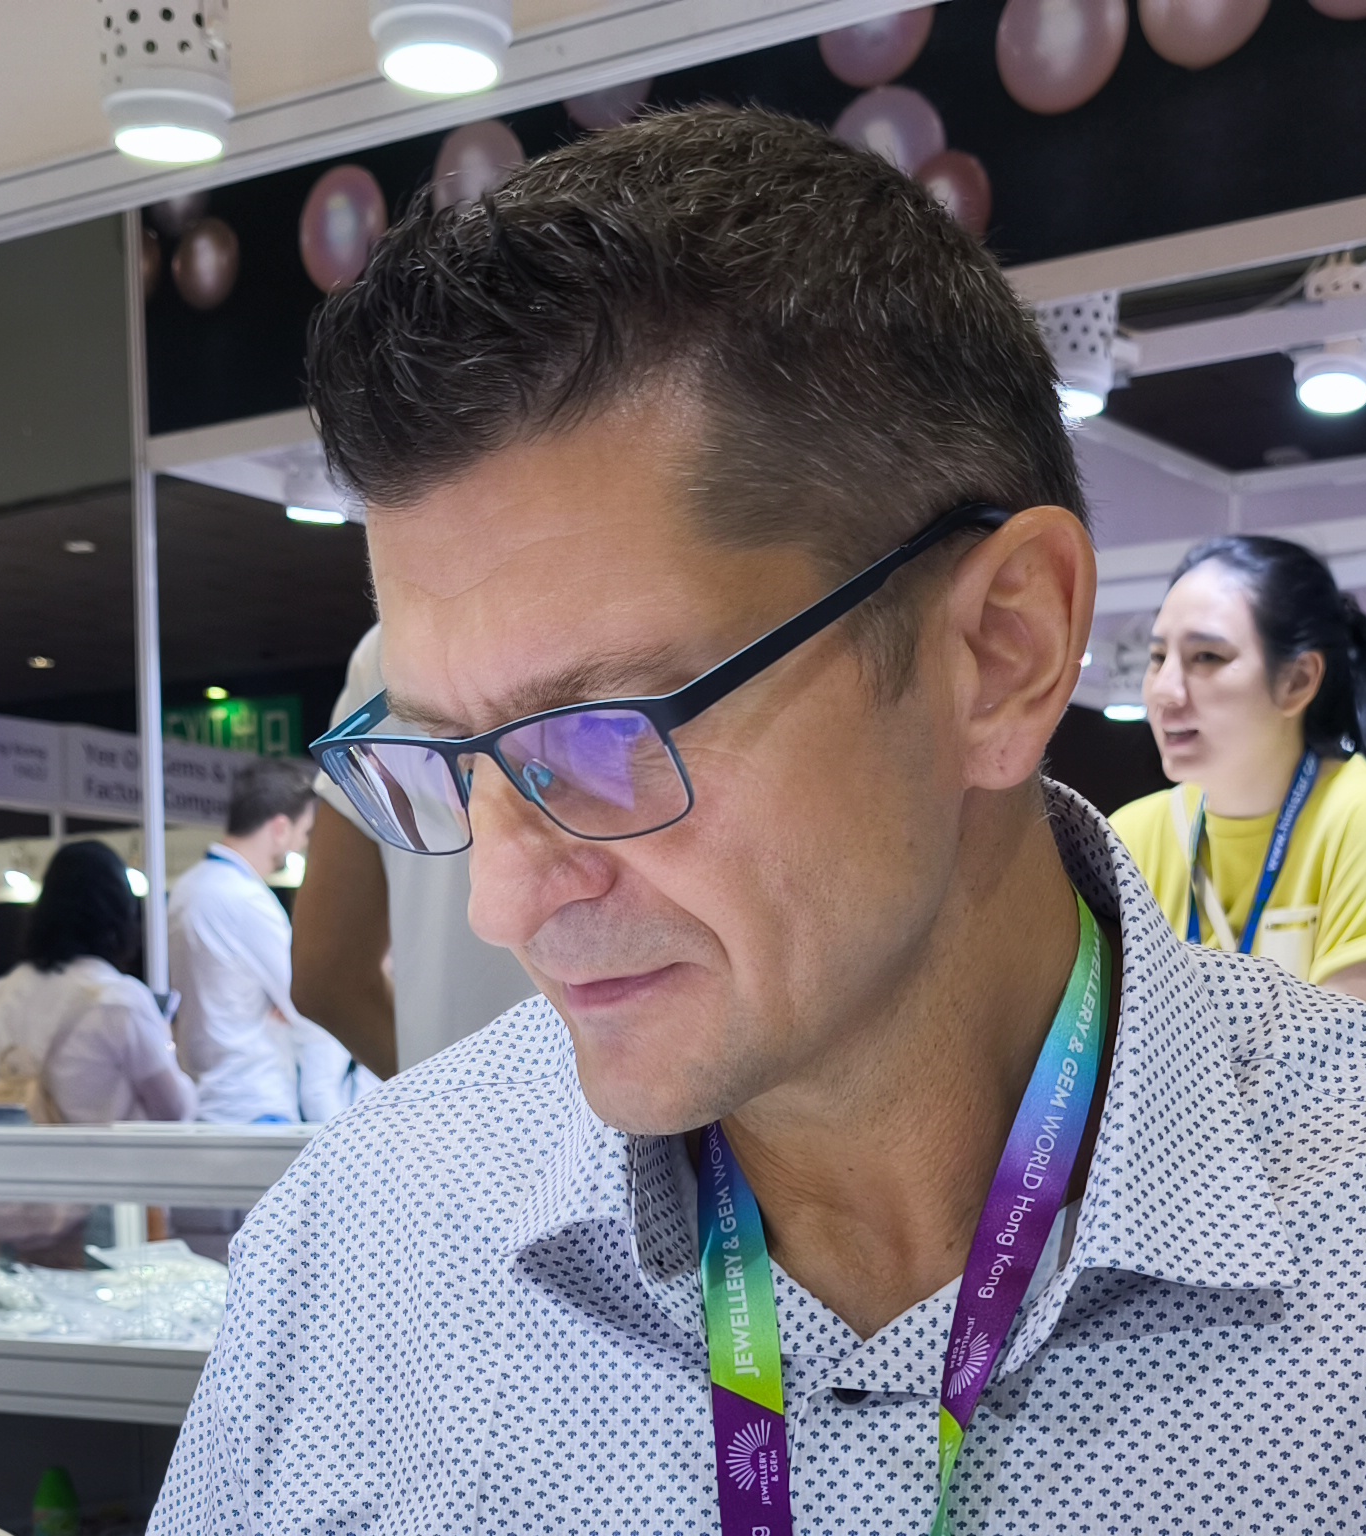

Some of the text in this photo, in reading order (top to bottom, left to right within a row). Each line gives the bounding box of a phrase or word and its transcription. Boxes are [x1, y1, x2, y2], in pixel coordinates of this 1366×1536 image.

[978, 920, 1101, 1299] EWELLERY & GEM WORLD Hong Kong
[716, 1185, 737, 1233] GEM
[722, 1234, 740, 1251] &
[724, 1254, 761, 1378] JEWELLERY
[956, 1316, 976, 1367] JEWELLERY
[759, 1451, 773, 1505] JEWELLERY
[769, 1449, 778, 1472] GEM
